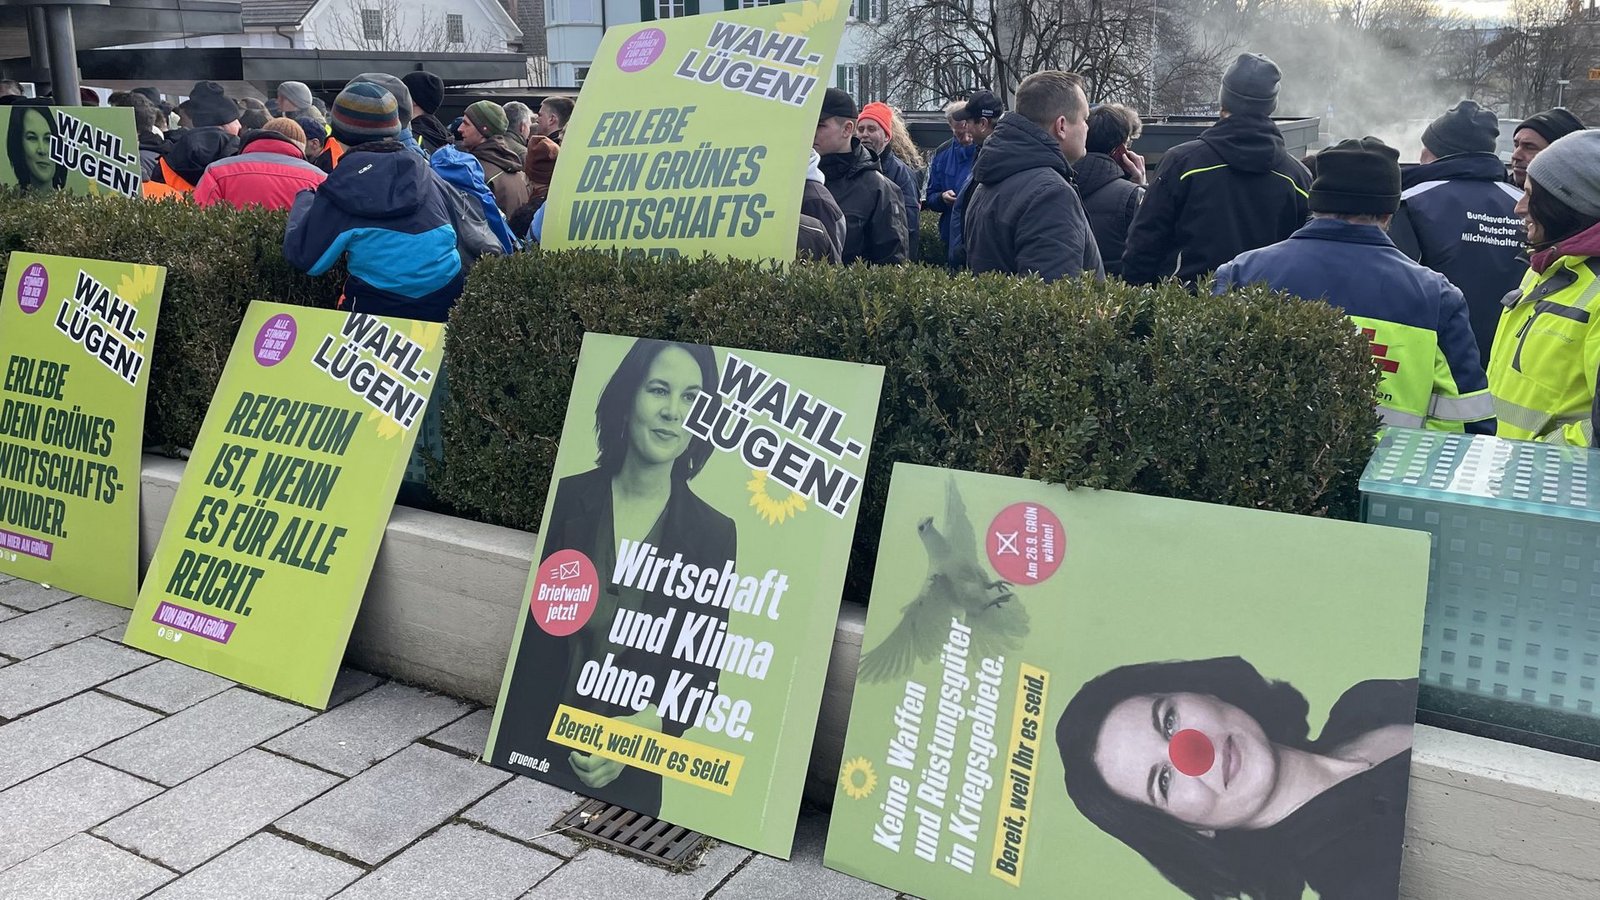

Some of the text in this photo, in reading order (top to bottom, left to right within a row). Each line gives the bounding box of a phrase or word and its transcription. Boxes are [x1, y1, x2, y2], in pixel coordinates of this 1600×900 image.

[707, 22, 821, 66] WAHL-
[677, 51, 816, 105] LÜGEN!
[57, 112, 135, 164] WAHL-
[588, 105, 697, 148] ERLEBE
[51, 136, 139, 196] LÜGEN!
[576, 142, 767, 192] DEIN GRÜNES
[568, 194, 775, 241] WIRTSCHAFTS-
[1462, 232, 1518, 247] Milchviehhalter
[1466, 212, 1526, 226] Bundesverband
[1479, 224, 1516, 236] Deutscher
[77, 272, 145, 341] WAHL-
[274, 318, 290, 330] ALLE
[56, 303, 143, 384] LÜGEN!
[341, 312, 431, 382] WAHL-
[4, 355, 70, 401] ERLEBE
[312, 336, 424, 427] LÜGEN!
[720, 356, 863, 458] WAHL-
[0, 398, 115, 458] DEIN GRÜNES
[224, 391, 362, 456] REICHTUM
[684, 391, 860, 516] LÜGEN!
[204, 443, 342, 511] IST, WENN
[20, 538, 30, 552] AN
[185, 495, 348, 574] ES FÜR ALLE
[1024, 506, 1038, 579] Am 26.9. GRÜN
[1042, 524, 1054, 562] wählen!
[165, 549, 265, 616] REICHT.
[538, 583, 592, 602] Briefwahl
[611, 538, 789, 621] Wirtschaft
[158, 605, 228, 640] VON HIER AN GRÜN.
[546, 603, 578, 624] jetzt!
[608, 608, 774, 681] und Klima
[576, 653, 754, 742] ohne Krise.
[508, 750, 550, 774] gruene.de
[554, 712, 731, 786] Bereit, weil Ihr es seid.
[872, 680, 927, 854] Keine Waffen
[914, 616, 972, 862] und Rüstungsgüter
[945, 654, 1006, 874] in Kriegsgebiete.
[995, 674, 1046, 878] Bereit, weil Ihr es seid.
